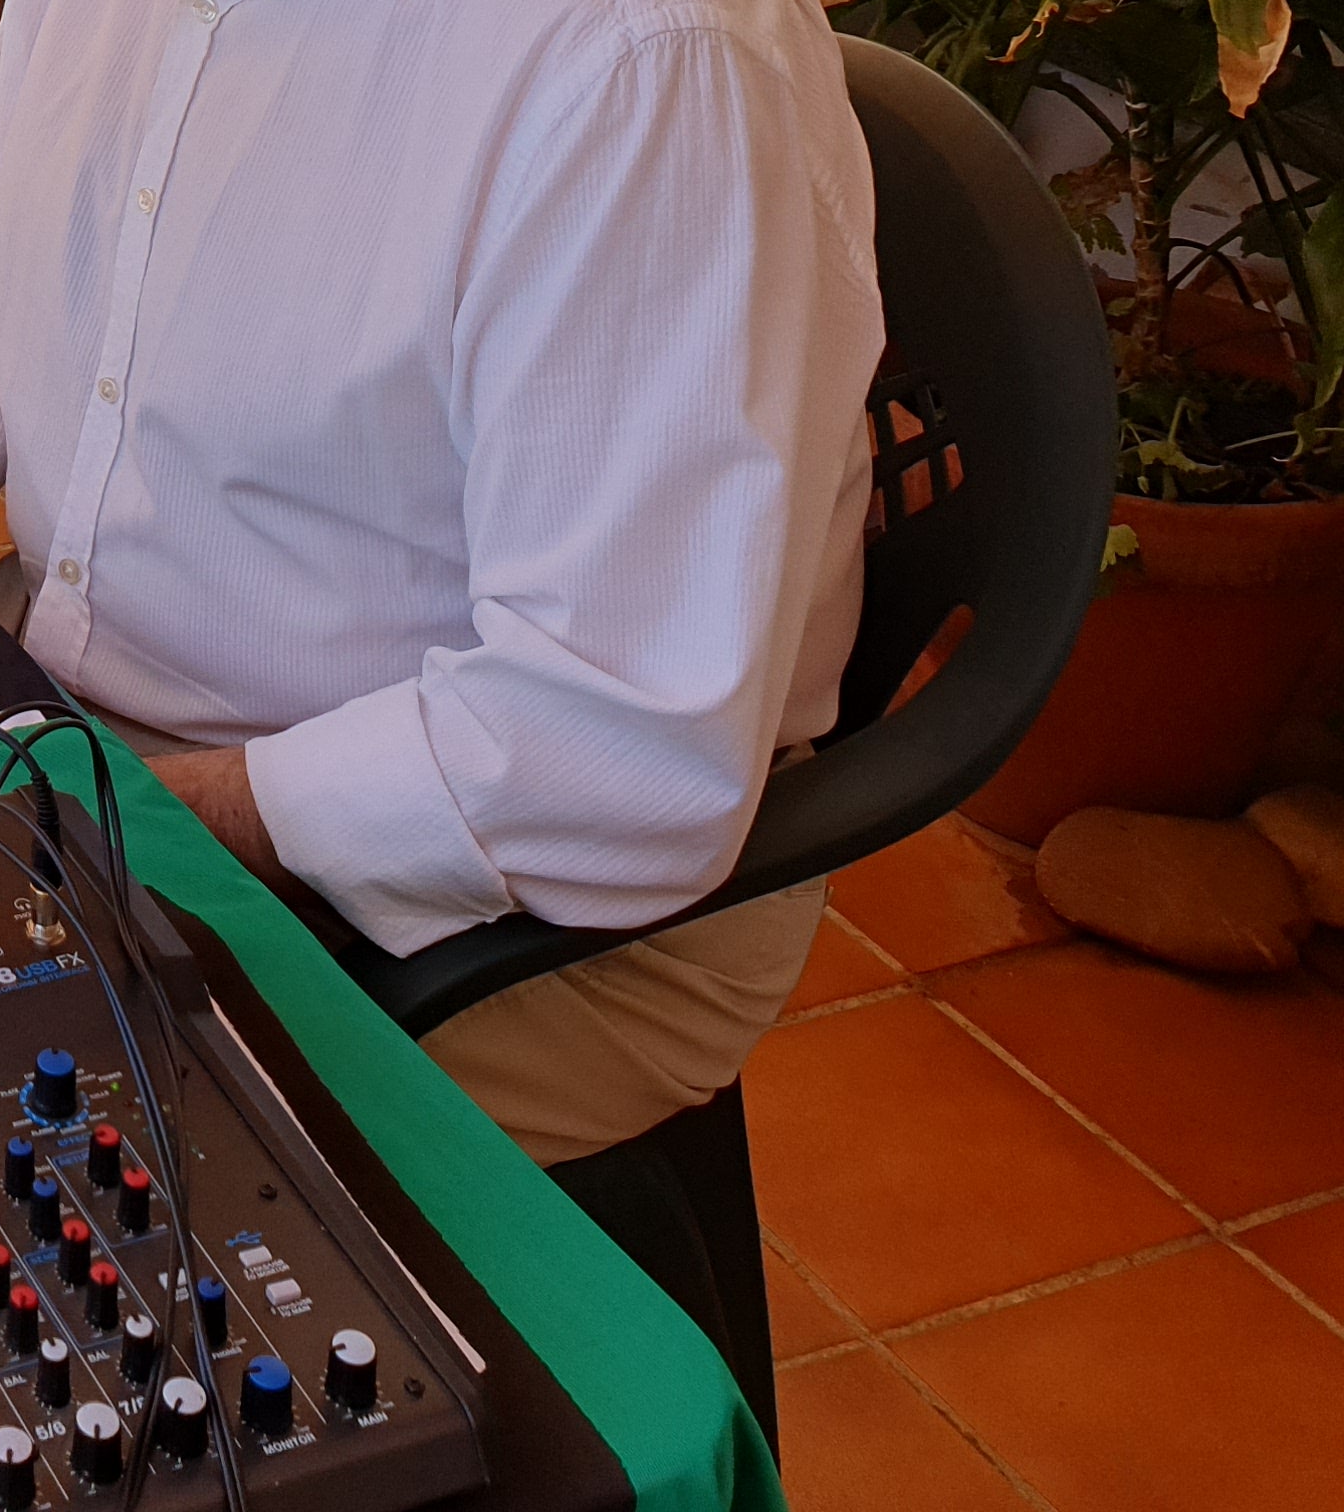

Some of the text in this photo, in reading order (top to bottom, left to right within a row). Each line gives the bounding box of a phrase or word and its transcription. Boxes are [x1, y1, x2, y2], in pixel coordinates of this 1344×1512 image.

[16, 958, 59, 981] USB
[55, 950, 86, 969] FX
[40, 964, 90, 984] INTERFACE
[87, 1349, 111, 1364] BAL
[3, 1374, 28, 1388] BAL
[357, 1412, 389, 1428] MAIN
[34, 1422, 66, 1441] 5/6
[262, 1432, 316, 1456] MONITOR
